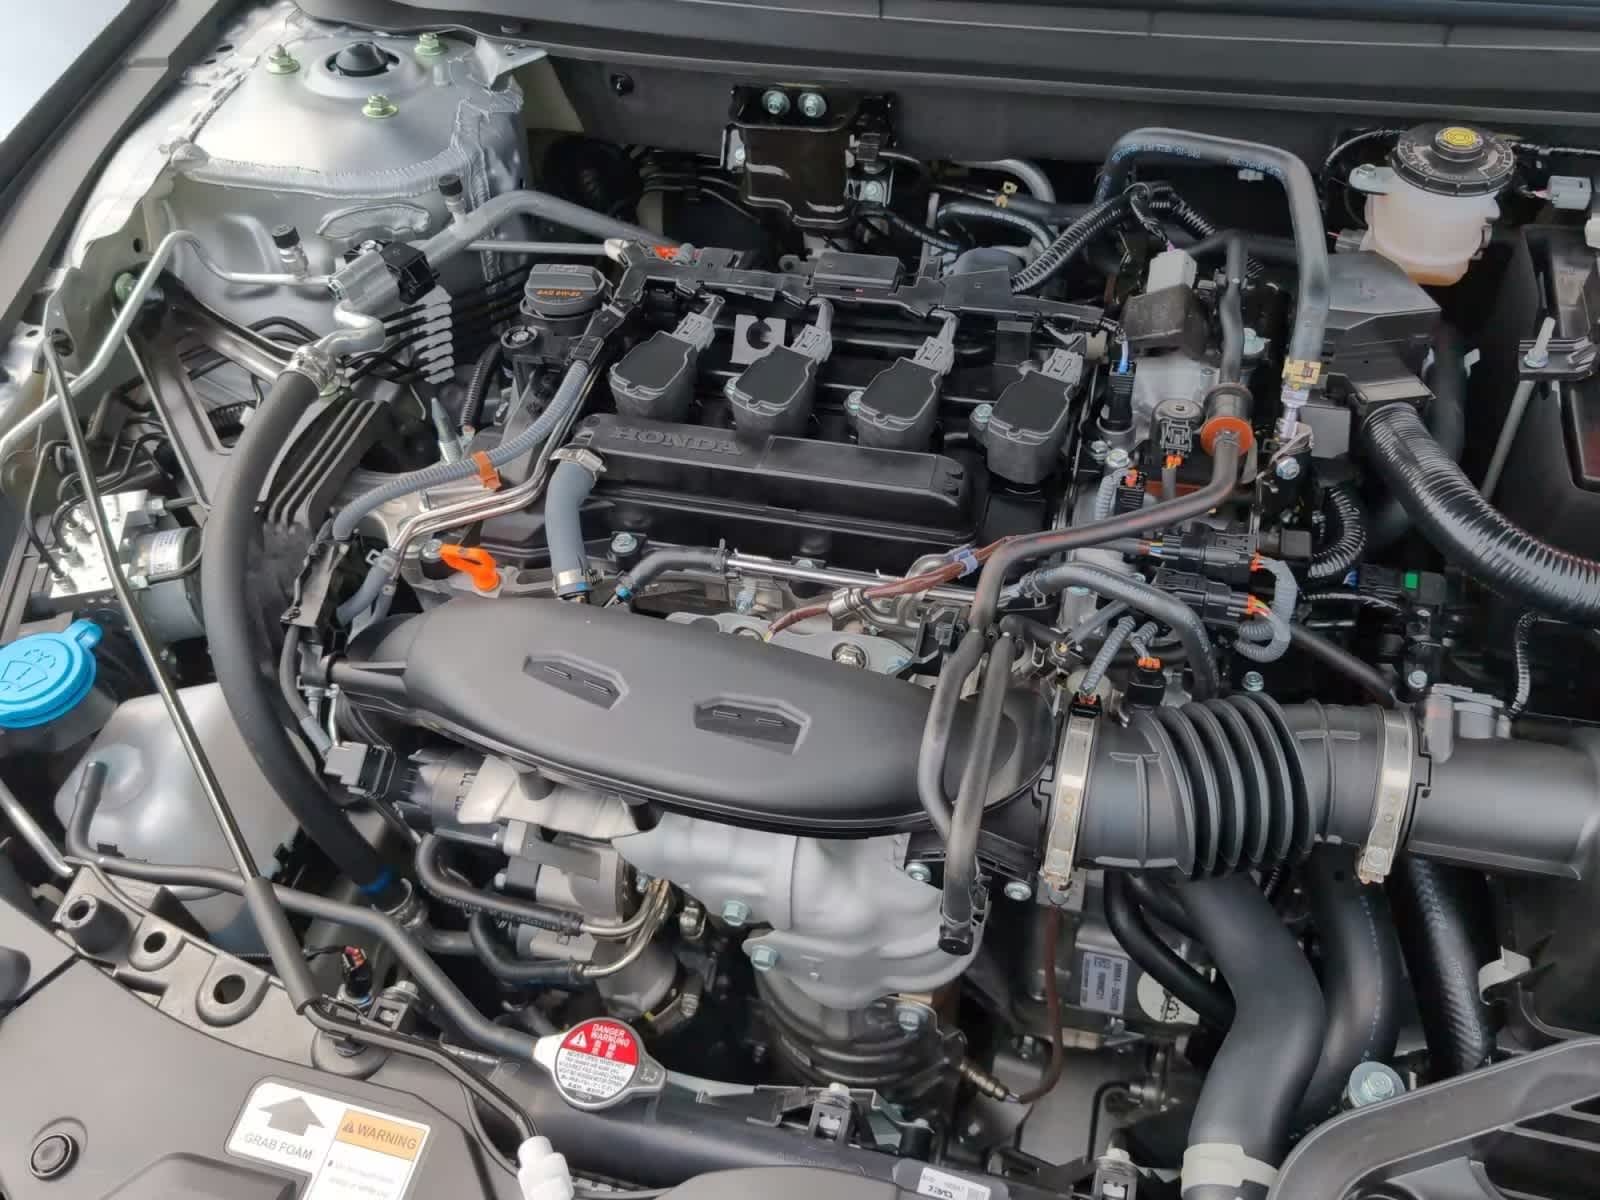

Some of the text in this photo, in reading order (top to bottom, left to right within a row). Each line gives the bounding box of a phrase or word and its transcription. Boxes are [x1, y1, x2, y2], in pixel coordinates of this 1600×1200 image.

[608, 426, 743, 456] HONDA
[591, 1031, 631, 1048] WARNING
[592, 1023, 625, 1038] DANGER
[244, 1132, 313, 1161] GRAB FOAM
[357, 1122, 418, 1150] WARNING
